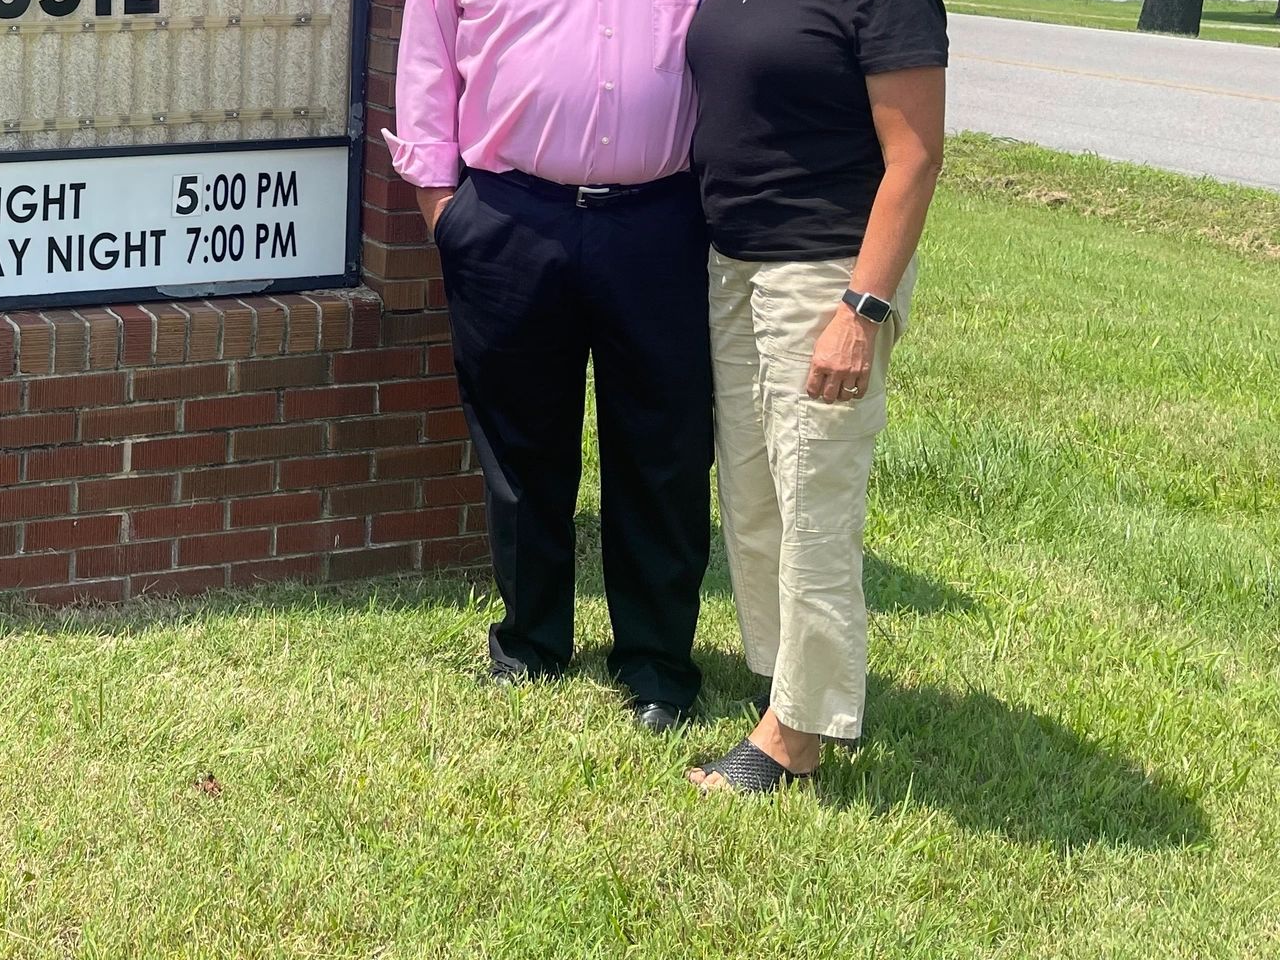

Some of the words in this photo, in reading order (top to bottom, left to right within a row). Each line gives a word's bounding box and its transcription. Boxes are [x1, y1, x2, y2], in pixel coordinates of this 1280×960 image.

[176, 173, 246, 214] 5:00
[257, 171, 298, 208] PM
[48, 230, 166, 273] NIGHT
[187, 224, 244, 263] 7:00
[256, 222, 296, 259] PM
